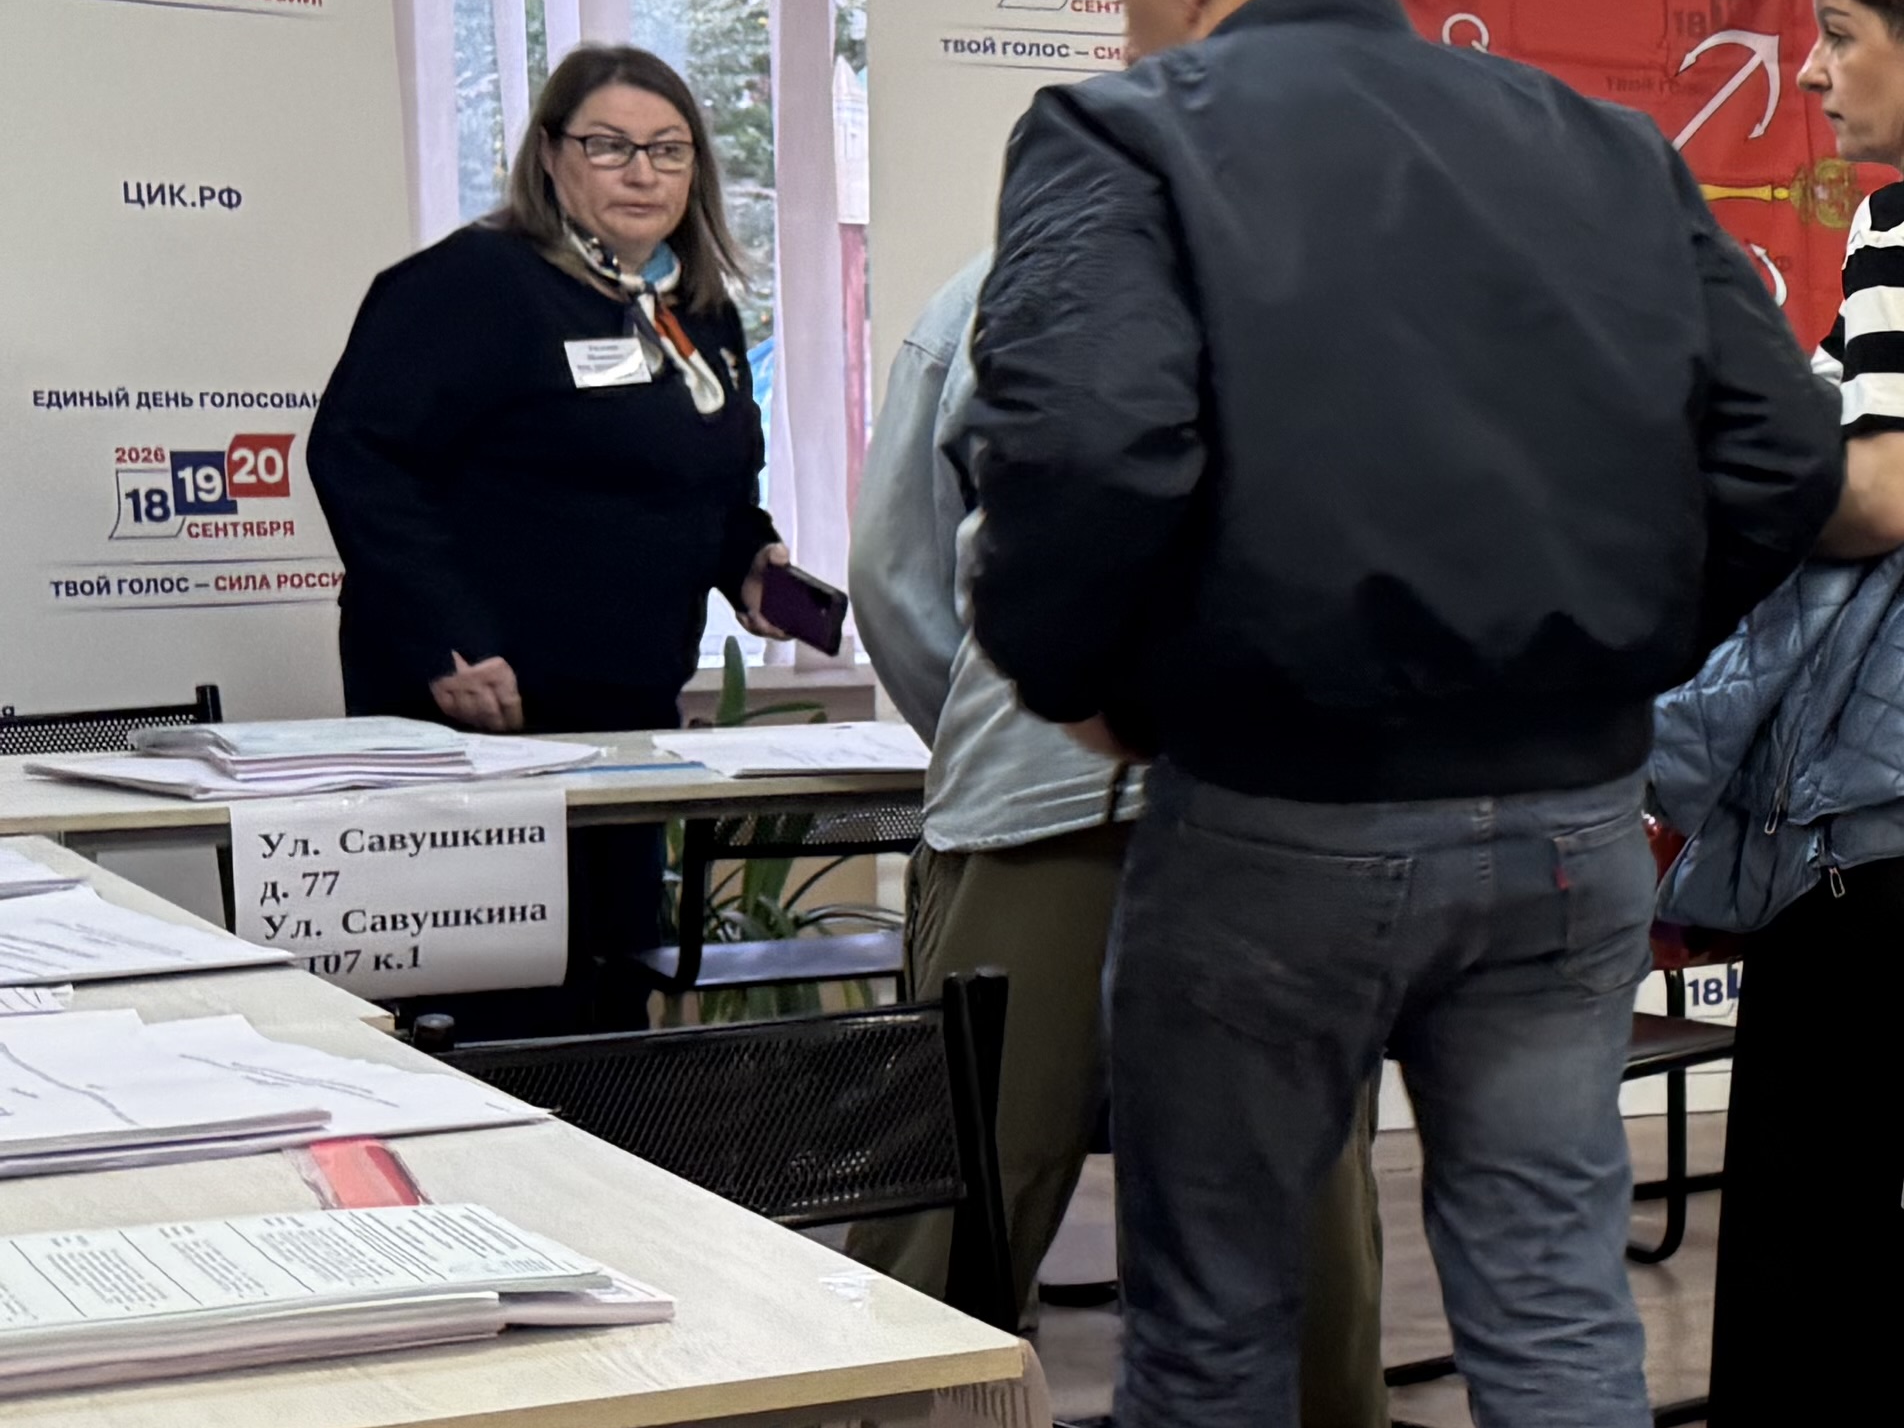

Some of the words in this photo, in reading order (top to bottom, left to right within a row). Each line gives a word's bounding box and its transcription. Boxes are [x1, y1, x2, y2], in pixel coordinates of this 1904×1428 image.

[940, 37, 996, 55] ТВОЙ
[1002, 41, 1070, 58] ГОЛОС
[122, 180, 243, 210] ЦИК.РФ
[33, 387, 130, 410] ЕДИНЫЙ
[136, 391, 194, 410] ДЕНЬ
[115, 447, 166, 464] 2026
[125, 488, 171, 523] 18
[177, 465, 223, 503] 19
[231, 447, 284, 484] 20
[187, 521, 296, 539] СЕНТЯБРЯ
[51, 577, 110, 598] ТВОЙ
[117, 577, 190, 595] ГОЛОС
[214, 575, 271, 592] СИЛА
[258, 833, 320, 858] Ул.
[339, 824, 546, 857] Савушкина
[260, 879, 289, 906] д.
[302, 870, 340, 897] 77
[262, 914, 322, 940] Ул.
[341, 902, 547, 936] Савушкина
[308, 949, 362, 974] 107
[373, 945, 421, 971] к.1
[1687, 978, 1723, 1006] 18
